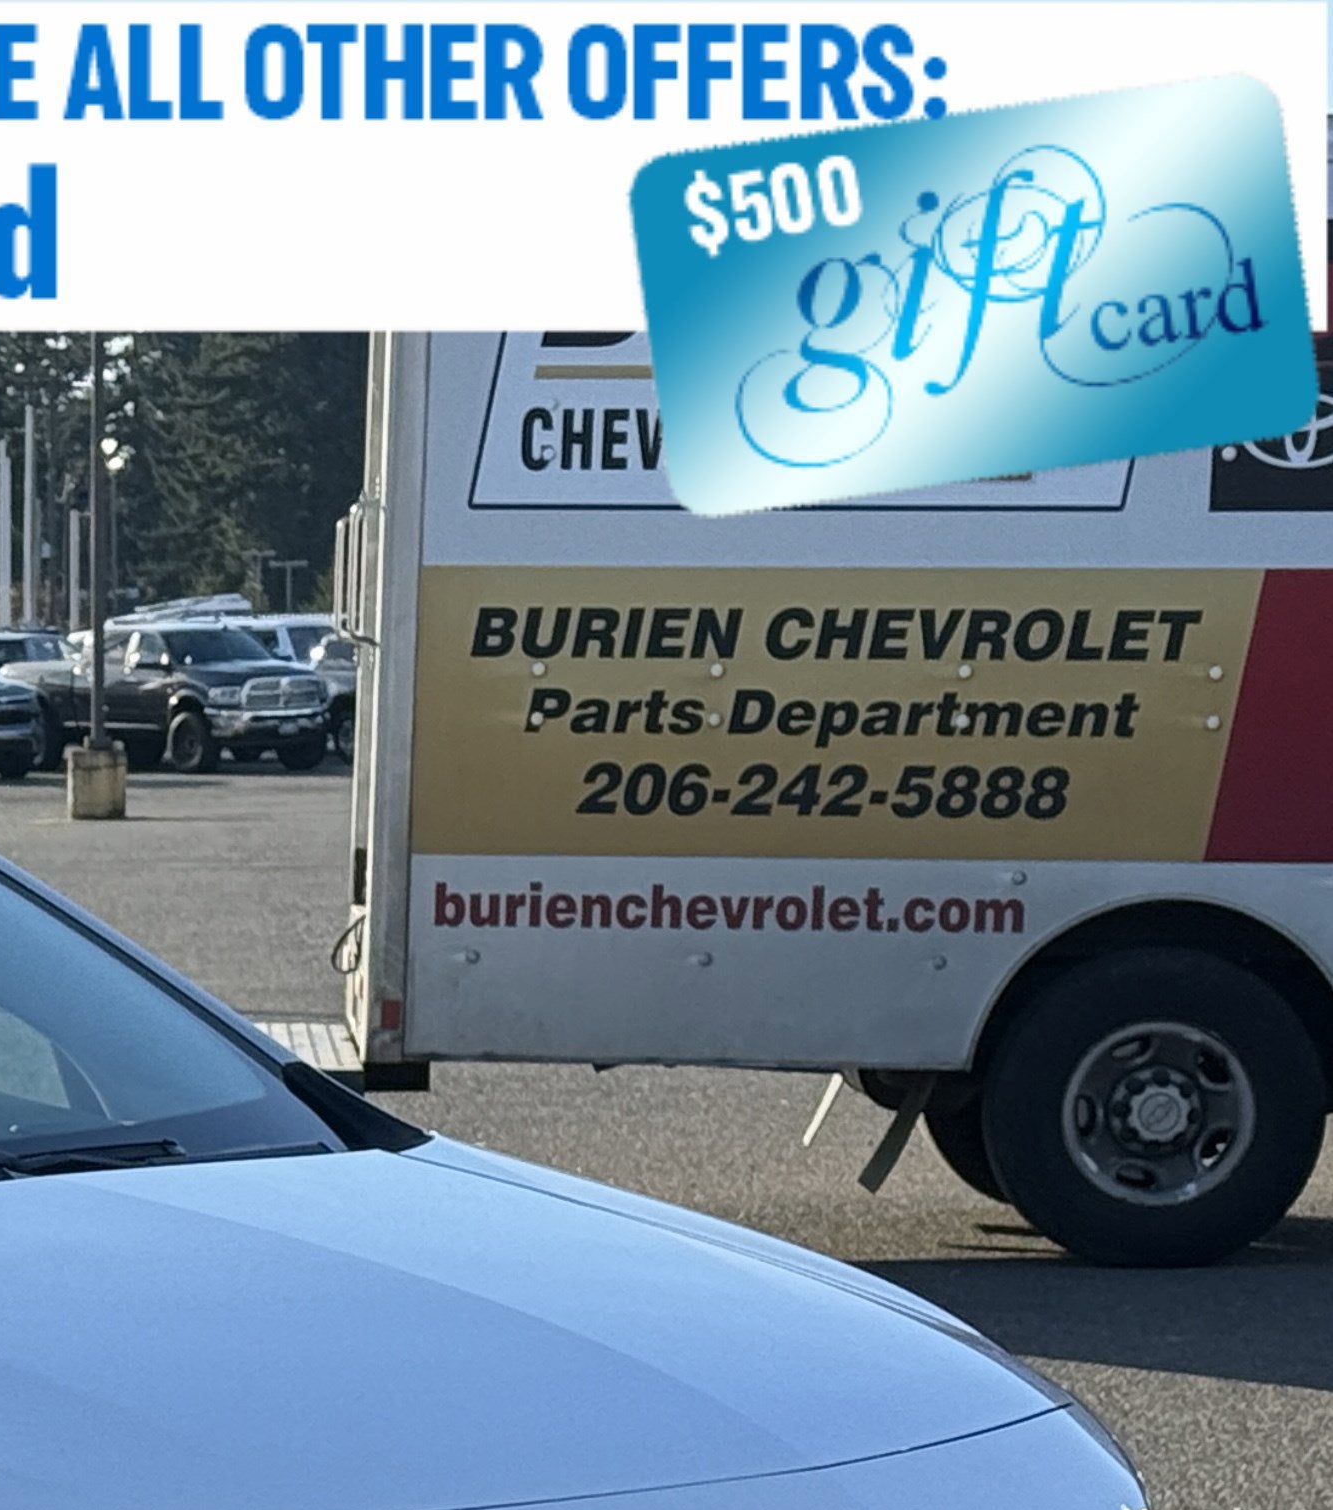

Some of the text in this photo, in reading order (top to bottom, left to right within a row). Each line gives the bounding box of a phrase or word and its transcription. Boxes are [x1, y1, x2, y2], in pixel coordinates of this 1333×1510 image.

[521, 405, 664, 472] CHEV
[469, 605, 1205, 664] BURIEN CHEVROLET
[523, 687, 1141, 750] Parts Department
[574, 761, 1072, 822] 206-242-5888
[433, 882, 1027, 934] burienchevrolet.com
